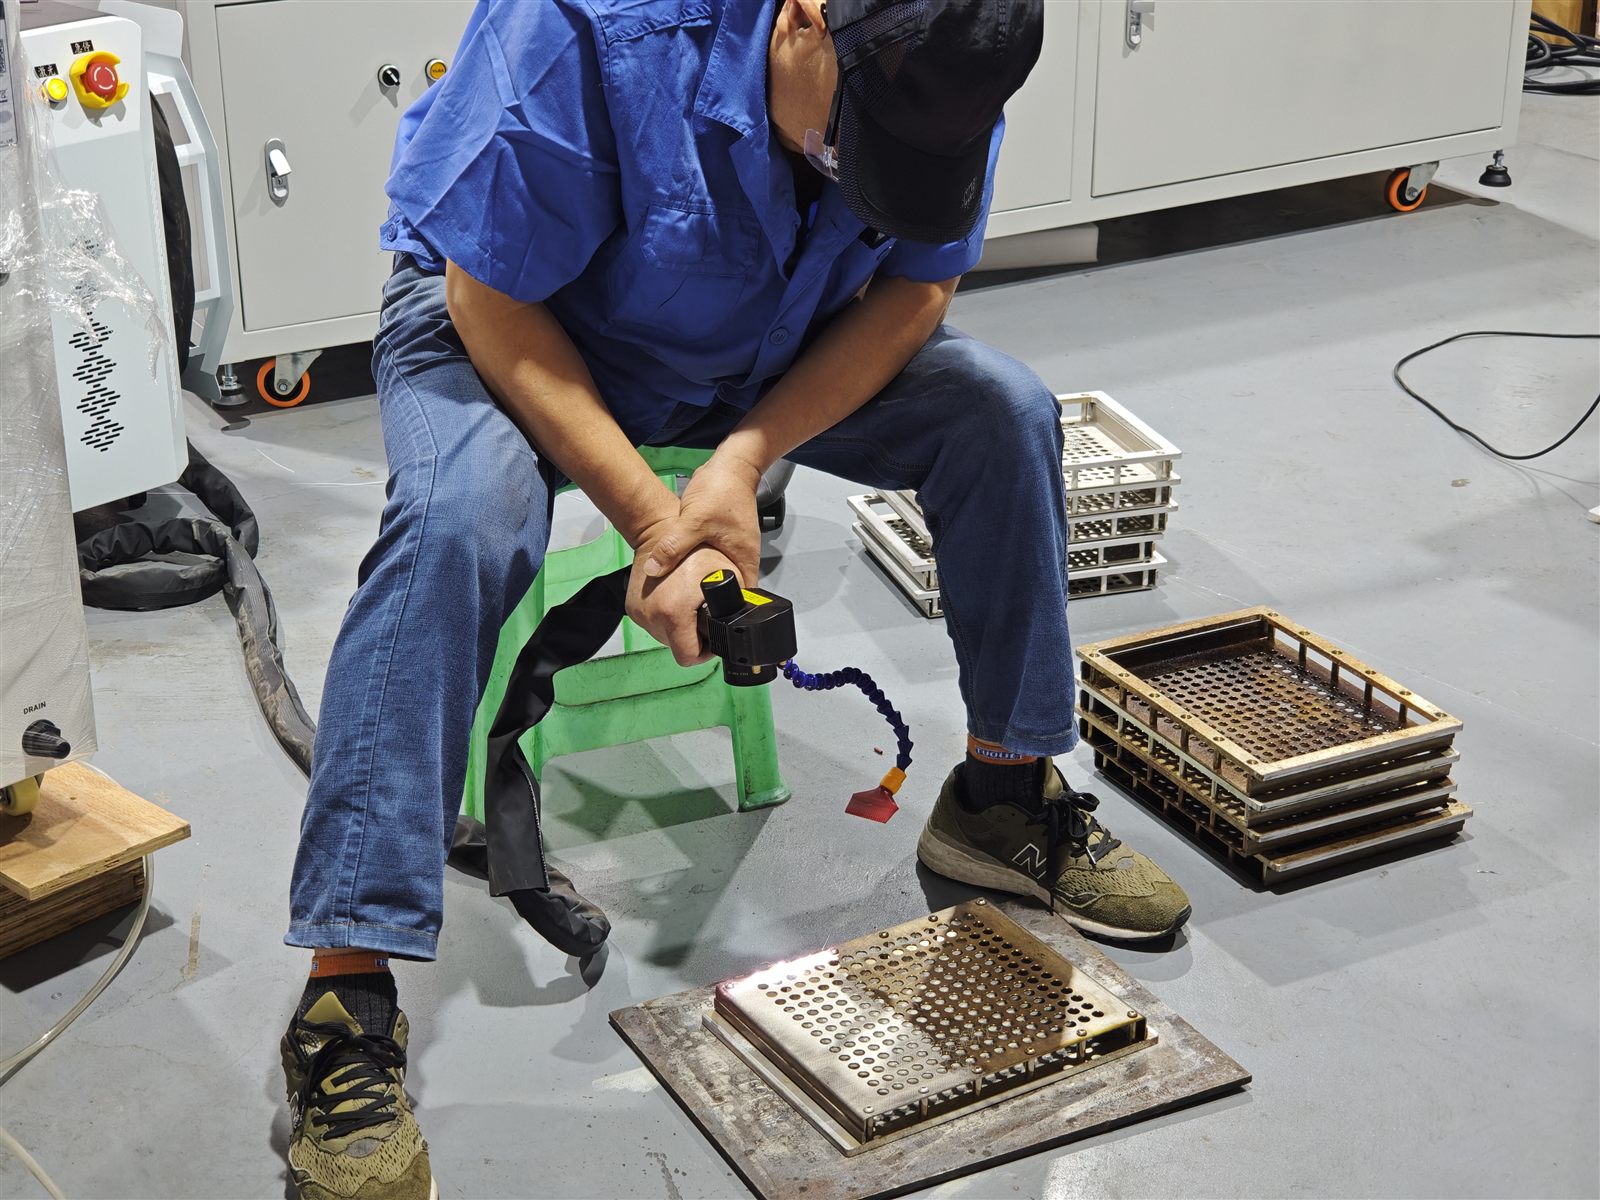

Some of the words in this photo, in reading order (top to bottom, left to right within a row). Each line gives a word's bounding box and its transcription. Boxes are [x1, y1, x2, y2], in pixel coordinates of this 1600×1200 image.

[74, 41, 91, 54] 急停
[38, 65, 57, 78] 激光
[23, 701, 46, 715] DRAIN
[1011, 842, 1047, 880] N
